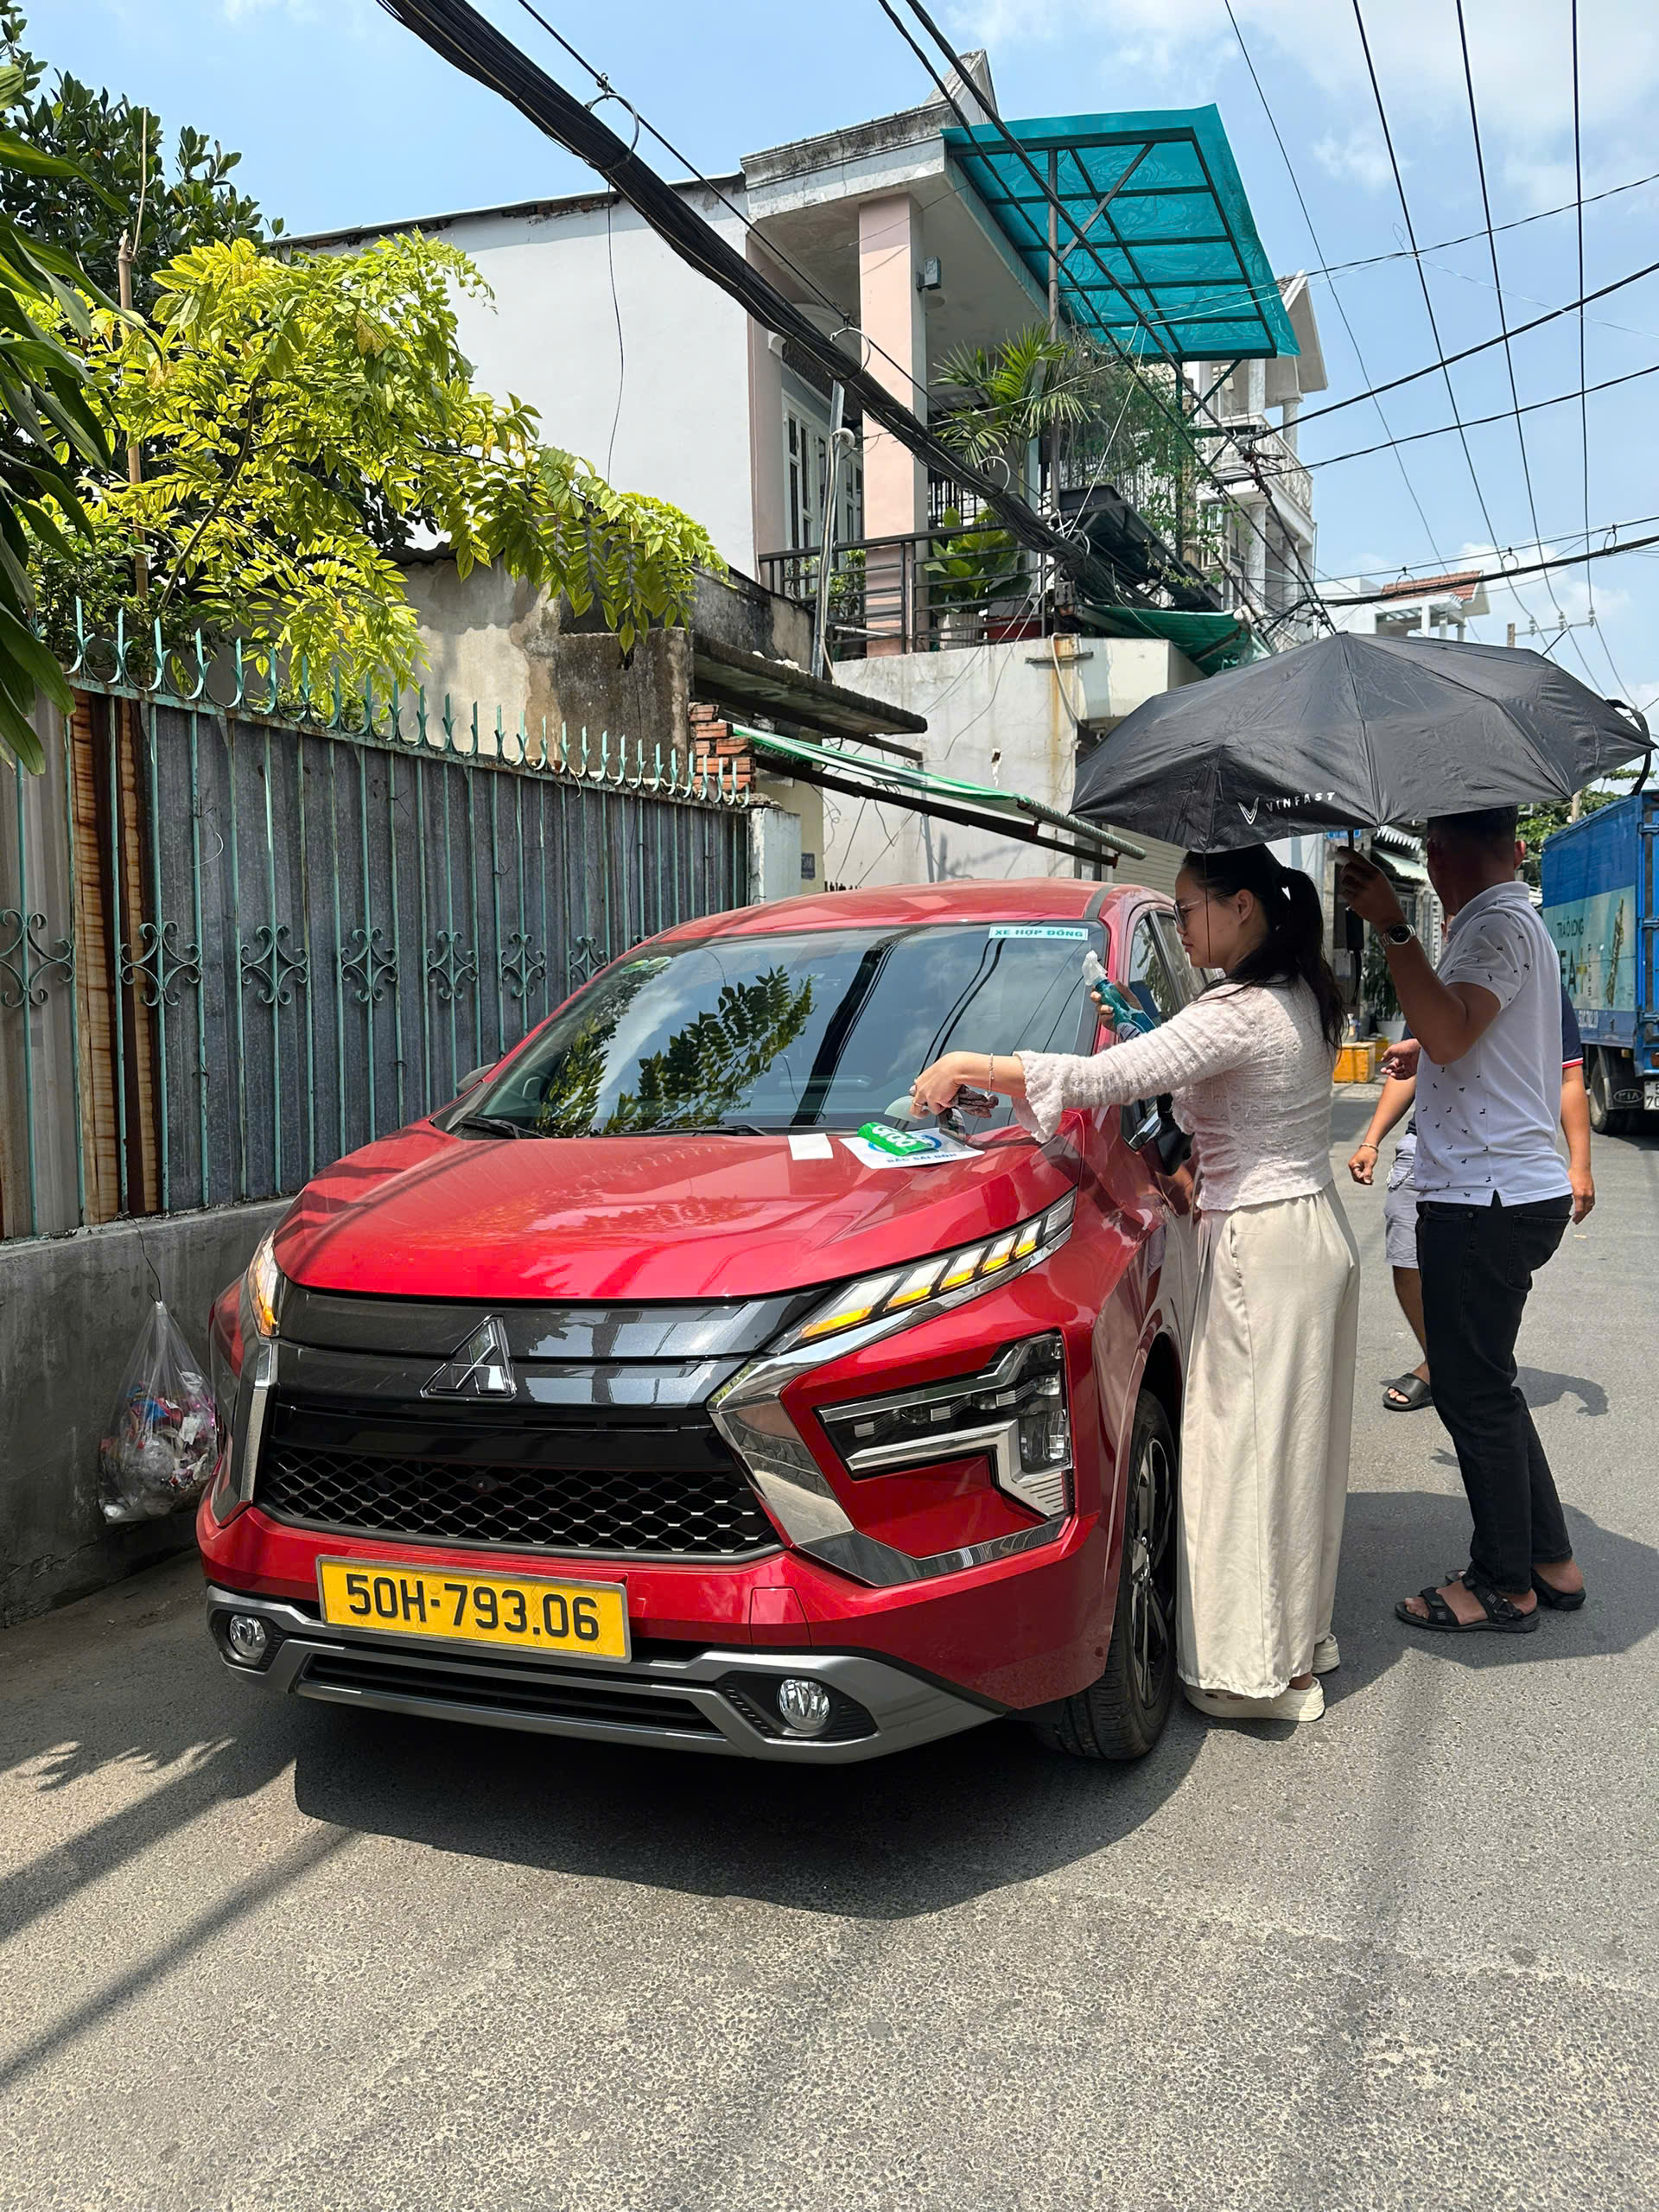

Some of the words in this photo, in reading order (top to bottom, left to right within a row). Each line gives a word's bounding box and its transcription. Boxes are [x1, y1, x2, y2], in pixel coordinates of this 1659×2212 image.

[1265, 791, 1336, 812] VINFAST
[871, 1125, 919, 1147] Grab
[346, 1573, 600, 1641] 50H-793.06
